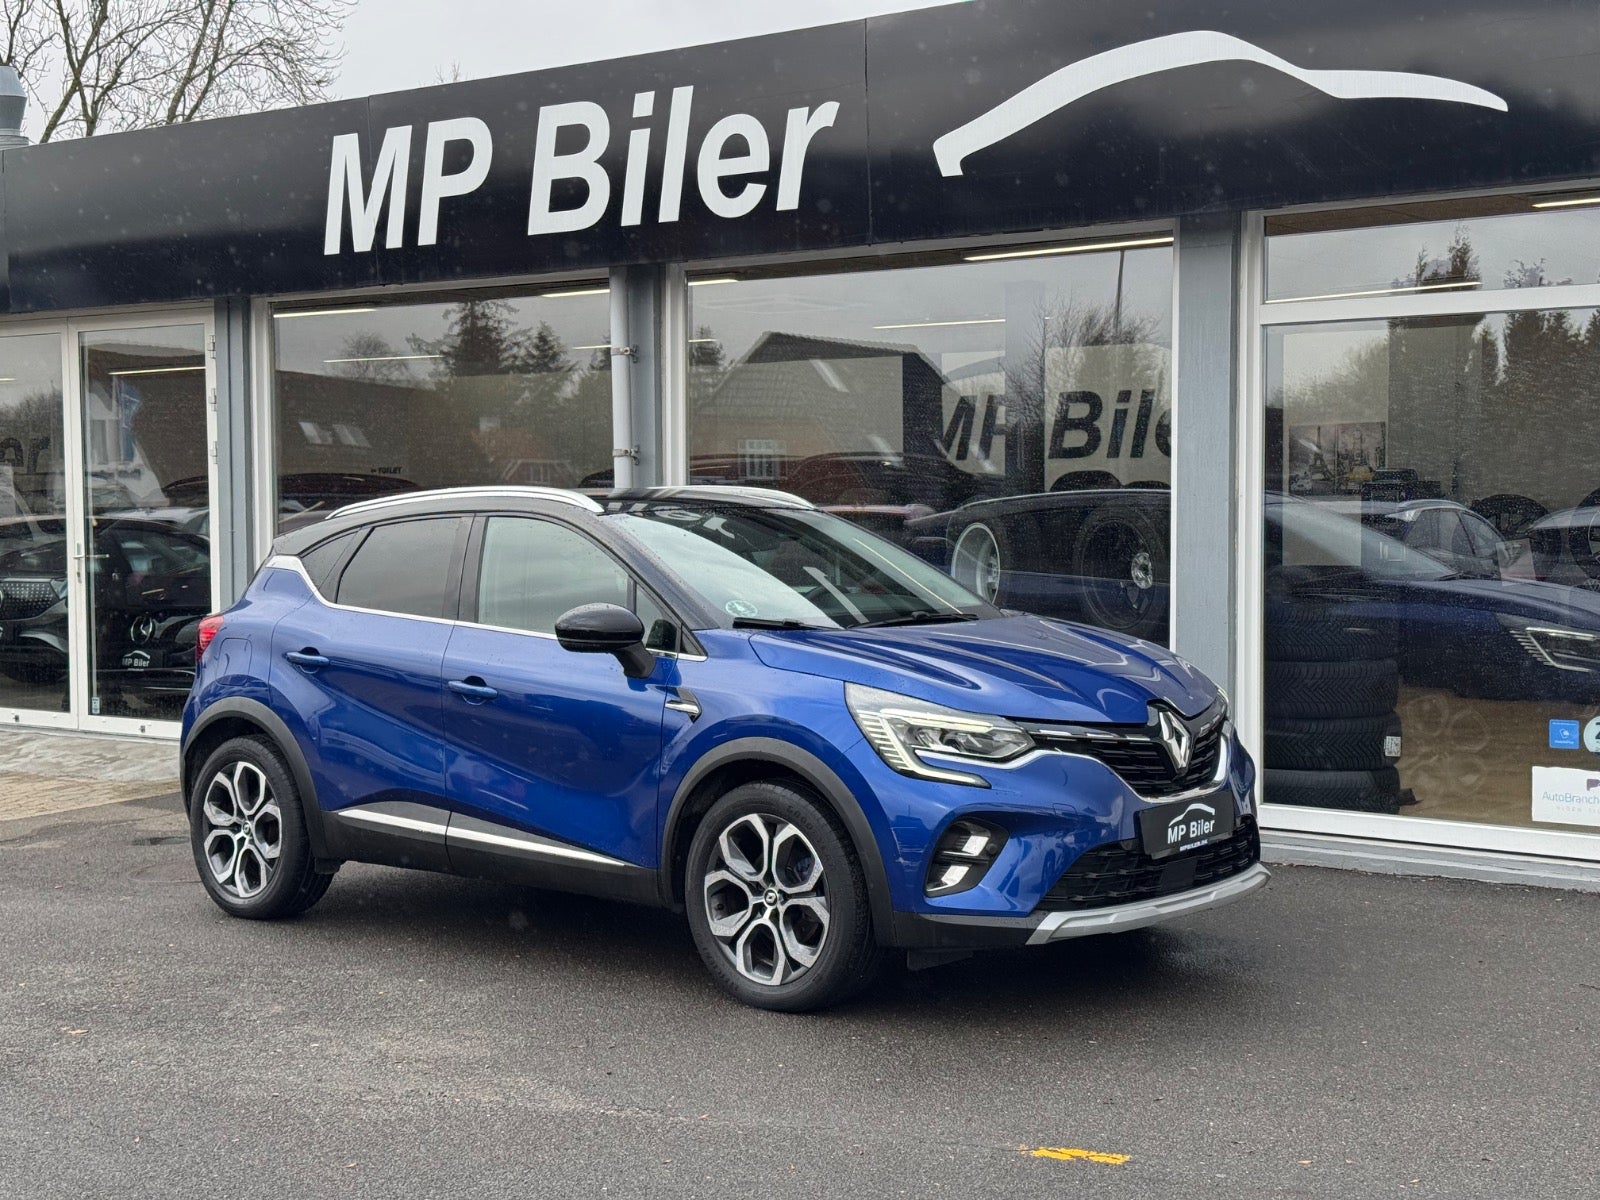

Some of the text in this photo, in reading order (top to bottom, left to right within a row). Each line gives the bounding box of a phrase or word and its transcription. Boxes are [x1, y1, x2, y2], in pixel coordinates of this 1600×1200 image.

[323, 85, 840, 256] MP Biler
[1167, 819, 1215, 844] MP Biler
